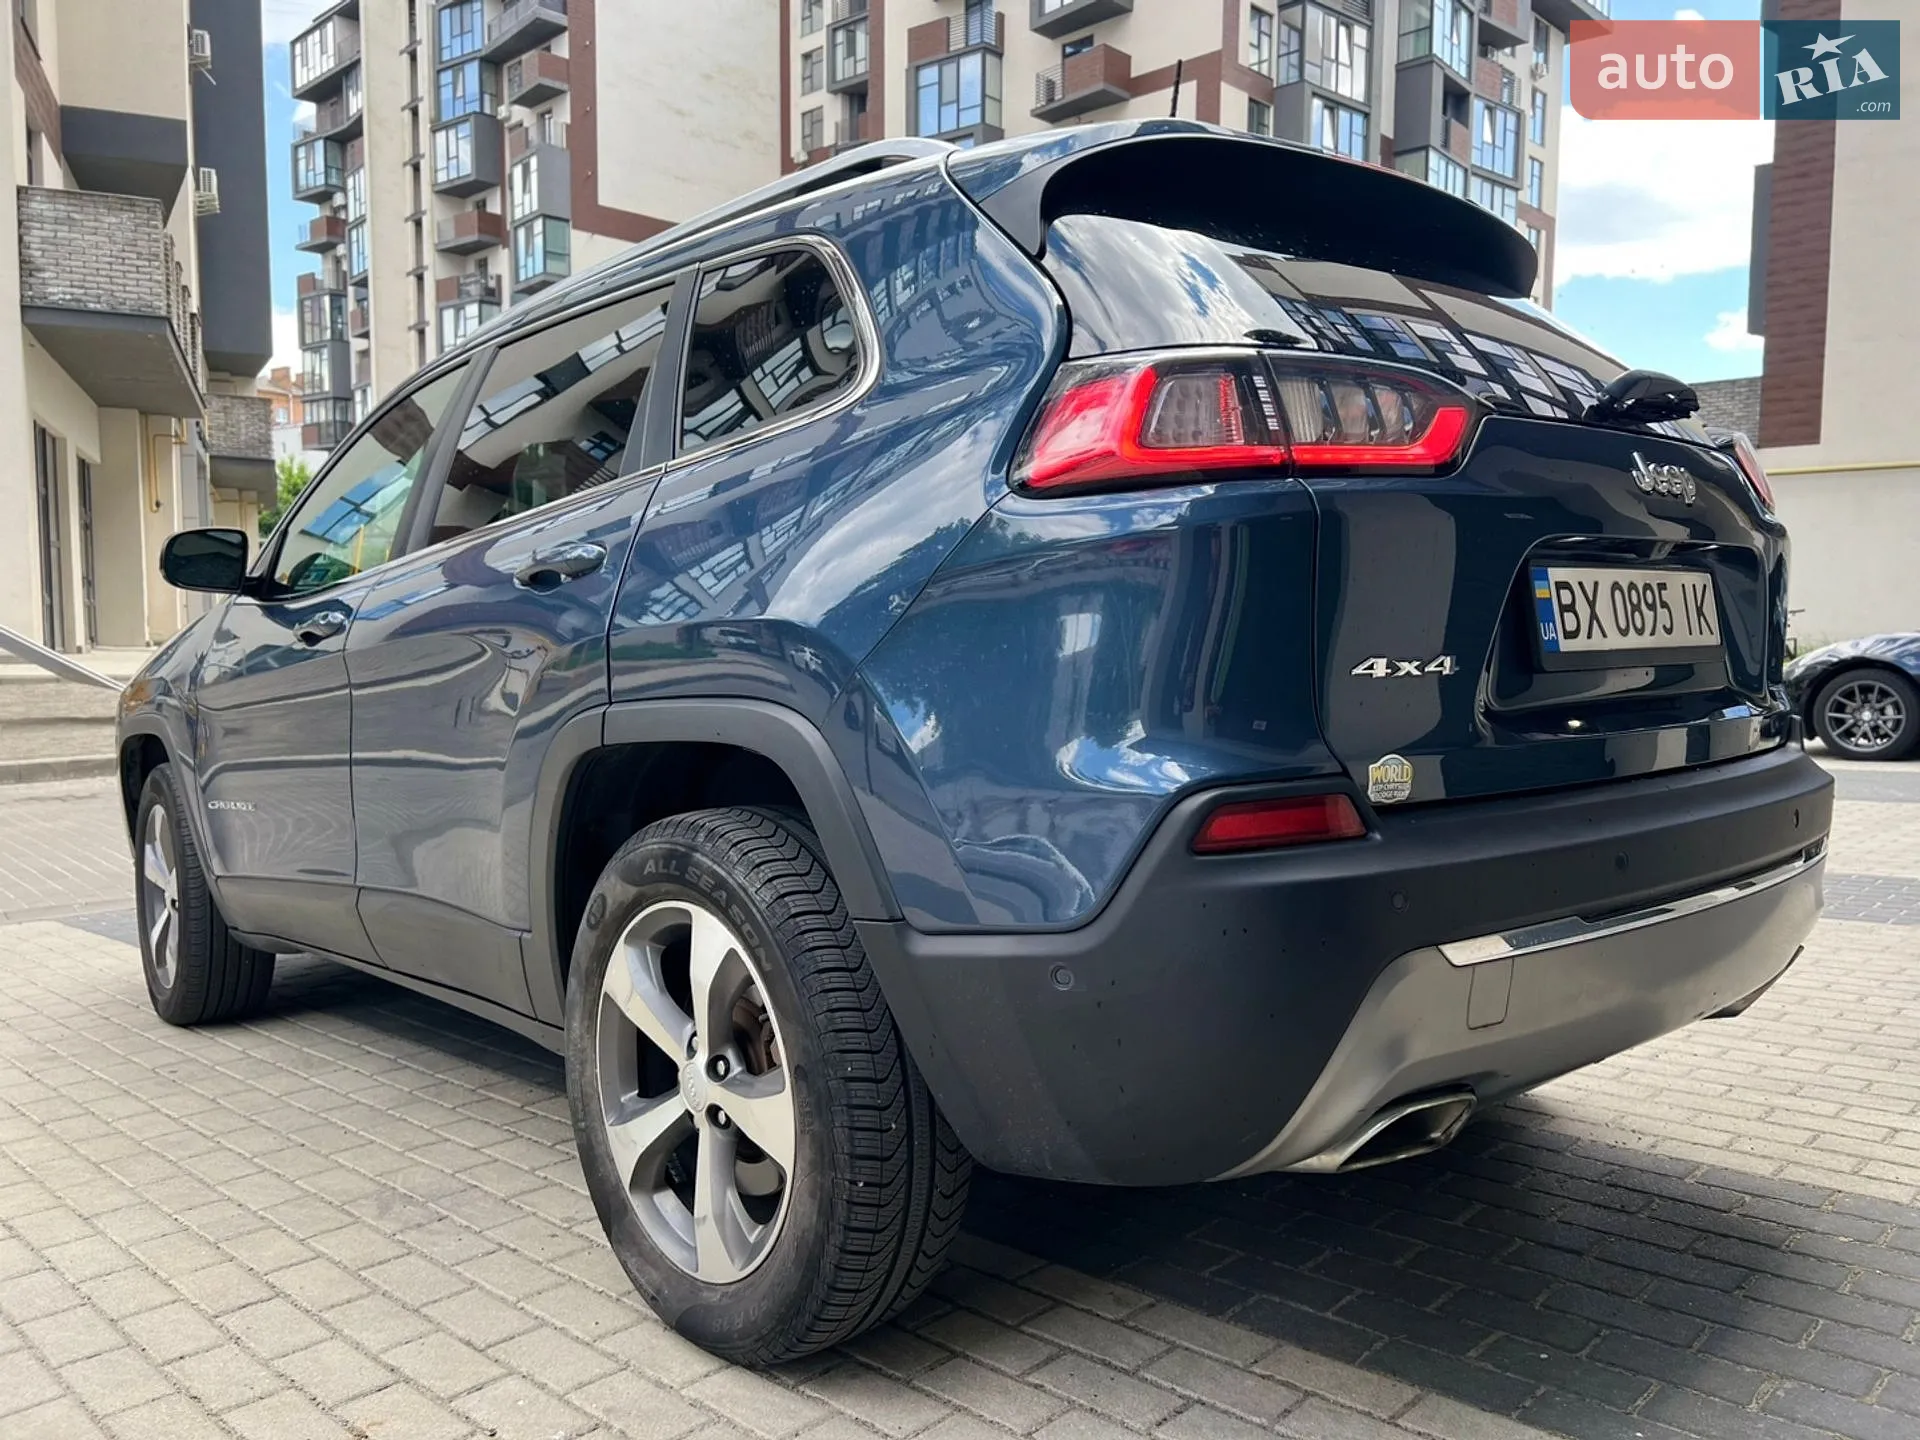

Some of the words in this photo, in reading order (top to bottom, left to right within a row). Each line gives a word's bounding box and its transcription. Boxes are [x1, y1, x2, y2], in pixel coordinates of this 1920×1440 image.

[1632, 451, 1696, 504] Jeep
[1554, 581, 1608, 640] BX
[1610, 581, 1673, 637] 0895
[1682, 583, 1714, 636] IK
[1540, 622, 1557, 641] UA
[1351, 655, 1460, 678] 4x4
[1371, 764, 1411, 784] WORLD
[643, 859, 680, 876] ALL
[685, 866, 772, 971] SEASON
